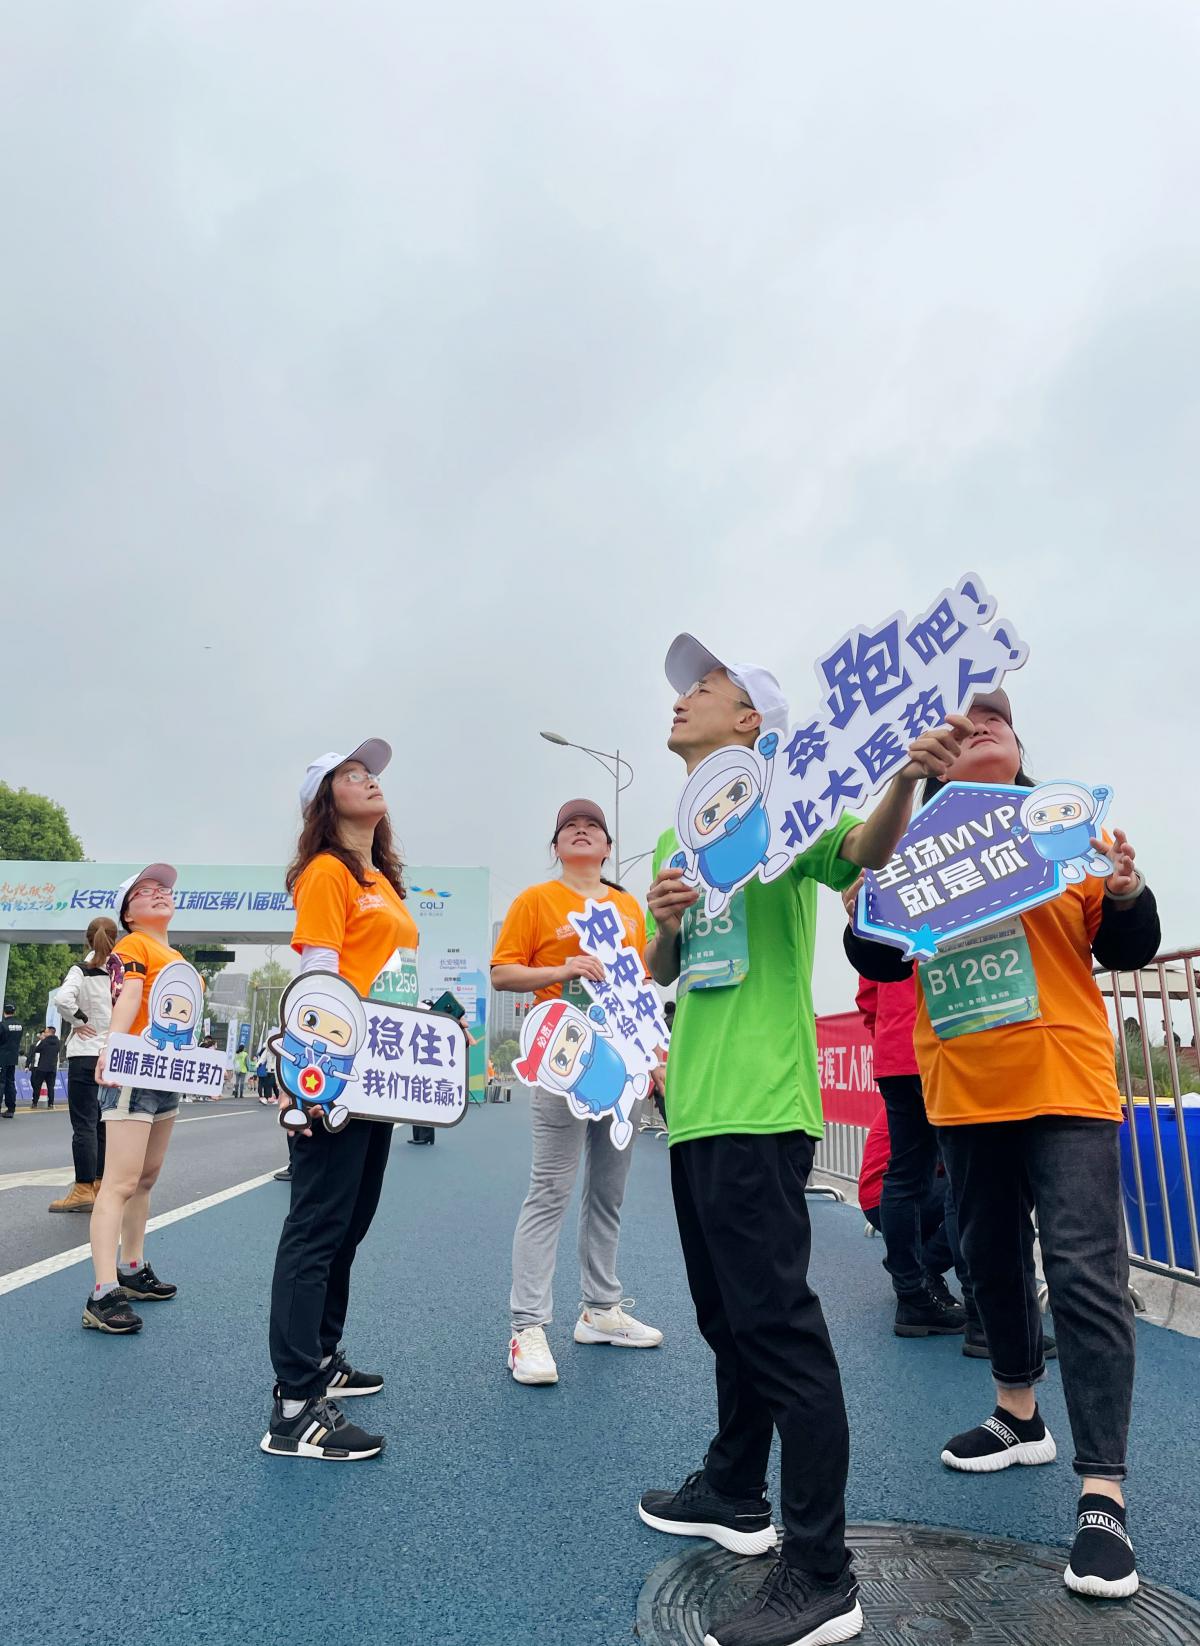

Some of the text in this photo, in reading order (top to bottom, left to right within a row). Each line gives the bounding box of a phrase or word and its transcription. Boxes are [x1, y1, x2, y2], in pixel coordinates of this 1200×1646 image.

[872, 805, 1016, 890] 全场MVP
[897, 839, 1029, 918] 就是你
[373, 971, 418, 994] B1259
[927, 948, 1024, 996] B1262
[367, 1015, 457, 1068] 稳住!
[109, 1048, 223, 1086] 创新 责任 信任 努力
[362, 1068, 464, 1107] 我们能赢!
